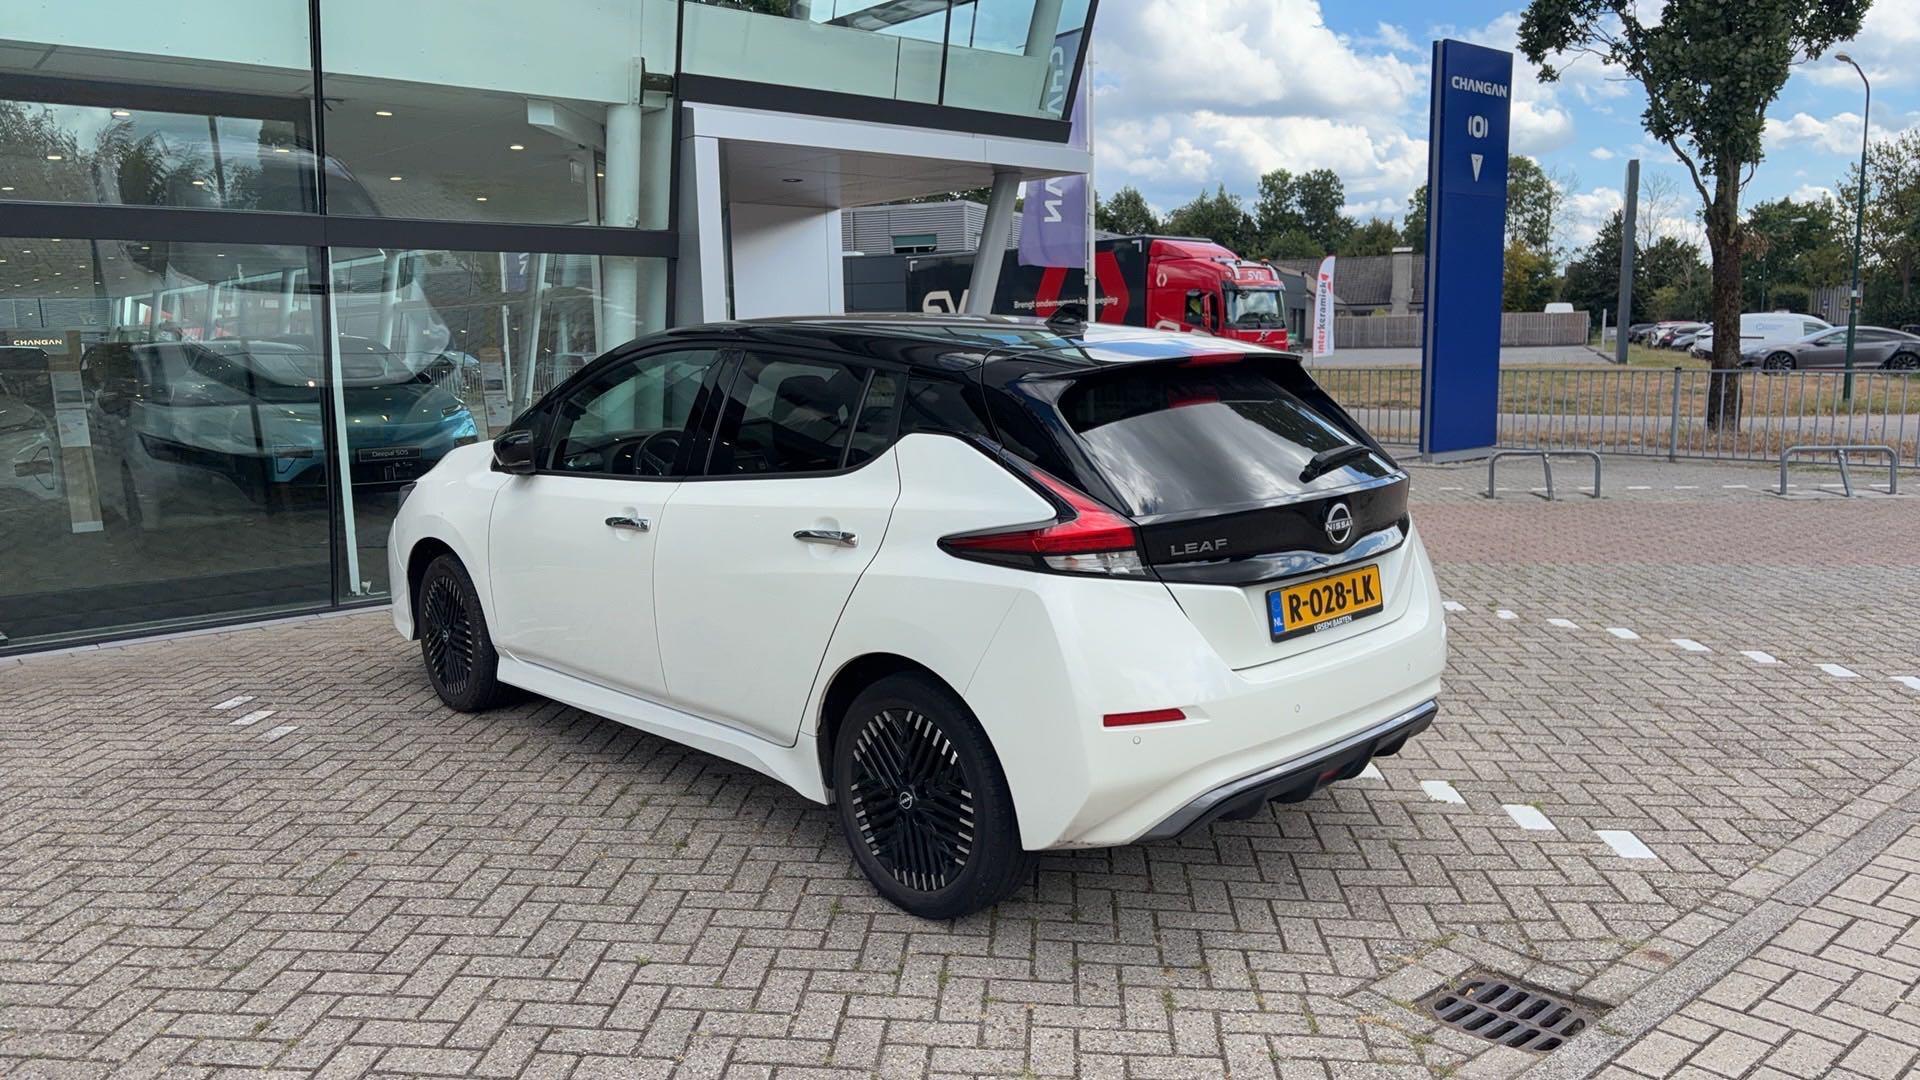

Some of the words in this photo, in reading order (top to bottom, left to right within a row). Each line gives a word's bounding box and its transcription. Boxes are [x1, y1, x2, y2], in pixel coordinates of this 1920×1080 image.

[1451, 75, 1508, 98] CHANGAN
[1014, 300, 1035, 311] Brengt
[1316, 281, 1327, 354] interkeramiek
[1325, 518, 1353, 531] NISSAN
[1170, 538, 1228, 556] LEAF
[1288, 574, 1375, 624] R-028-LK
[1273, 617, 1284, 627] NL
